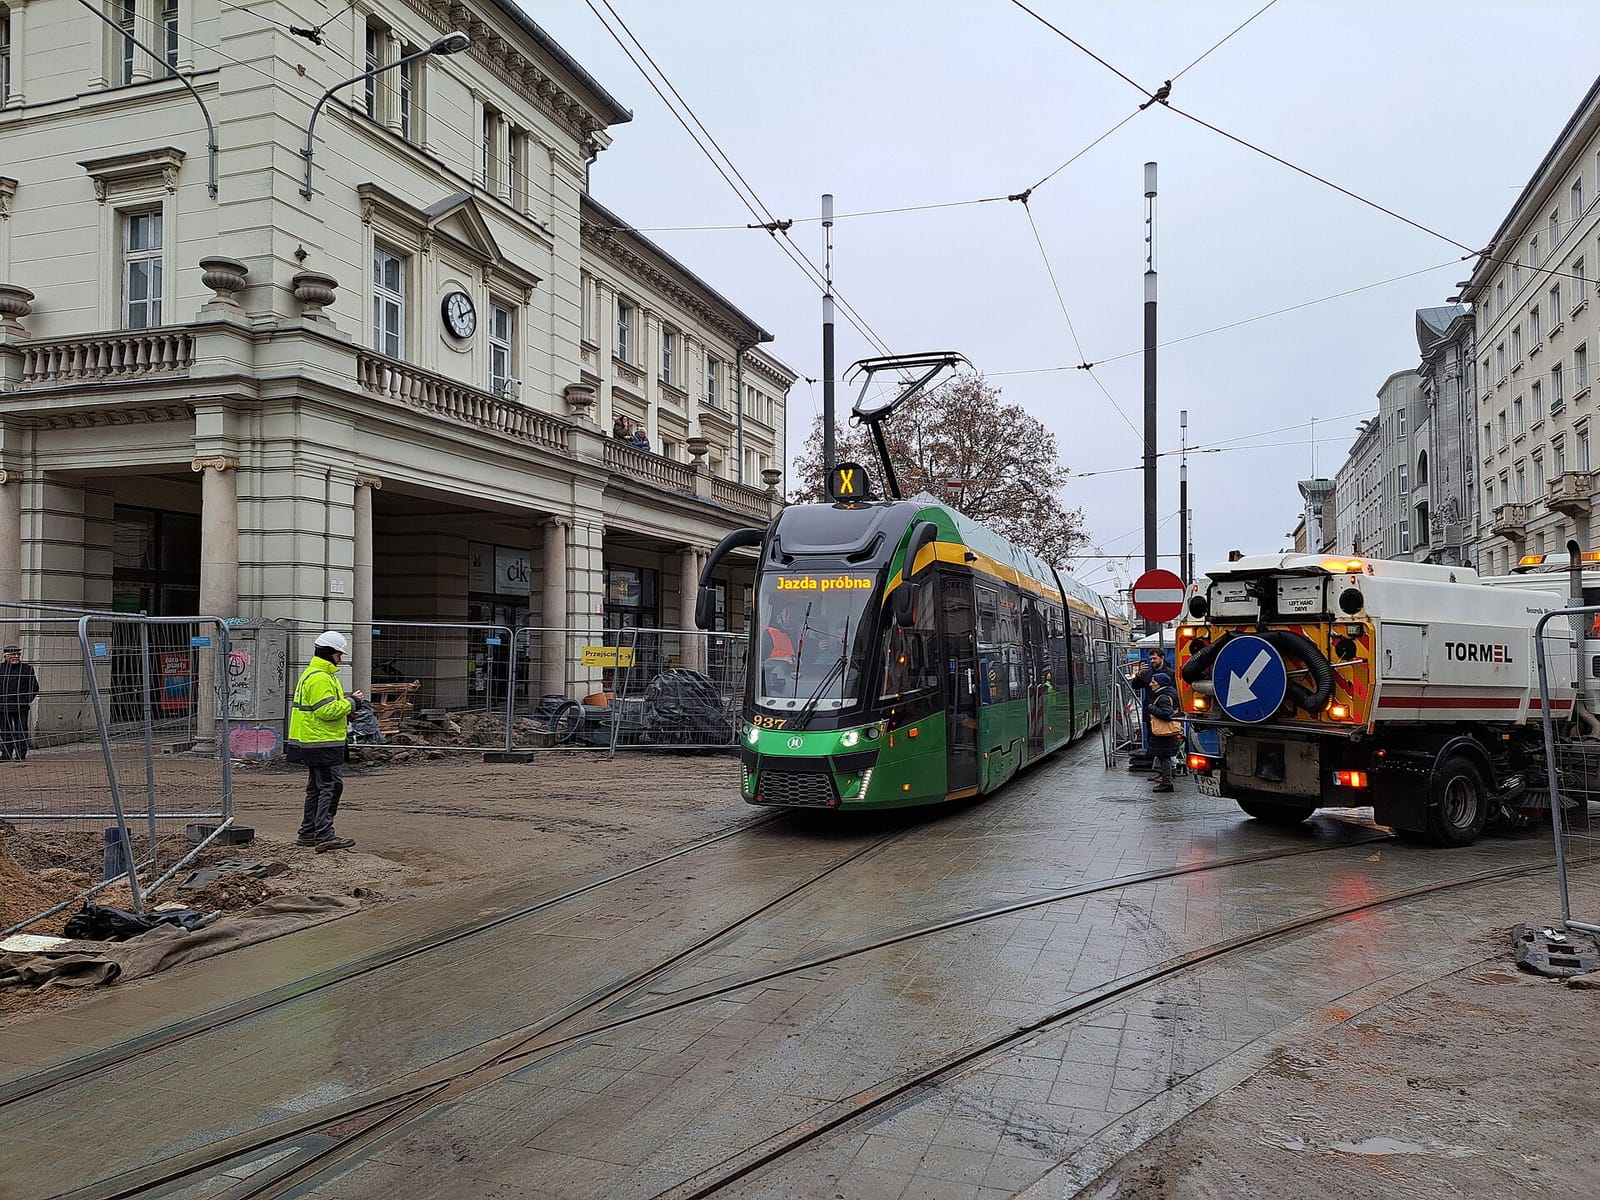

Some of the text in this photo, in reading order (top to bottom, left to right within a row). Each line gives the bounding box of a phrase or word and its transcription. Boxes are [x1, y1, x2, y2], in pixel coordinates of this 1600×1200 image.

[840, 469, 854, 494] X
[507, 557, 529, 583] cik
[776, 576, 872, 592] Jazda próbna
[585, 650, 617, 658] Przejście
[1445, 642, 1513, 663] TORMEL
[753, 714, 788, 730] 937
